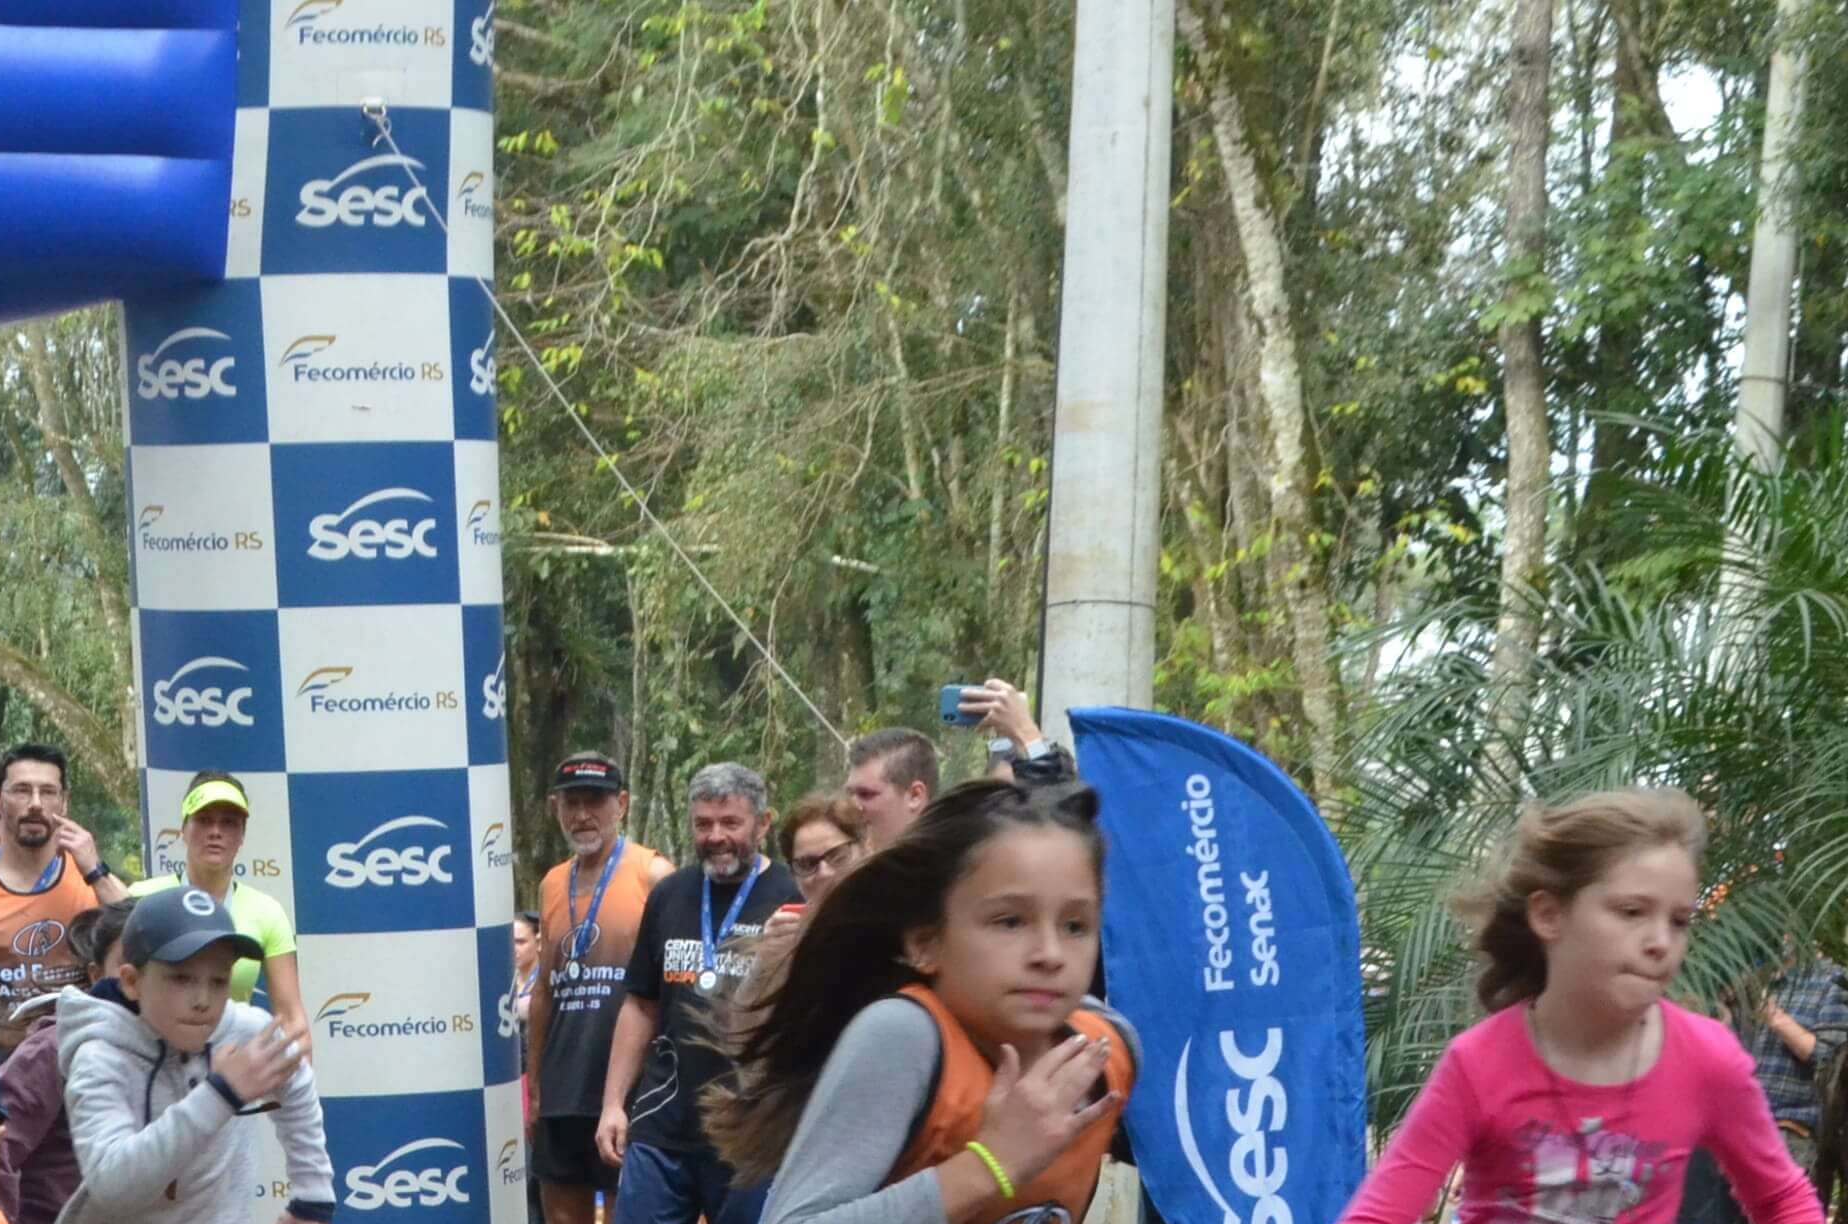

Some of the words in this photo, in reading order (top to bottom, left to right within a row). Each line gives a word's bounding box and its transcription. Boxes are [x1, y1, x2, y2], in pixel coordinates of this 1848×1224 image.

[299, 24, 419, 46] Fecomércio
[424, 27, 446, 46] RS
[295, 179, 426, 228] Sesc
[137, 354, 237, 399] Sesc
[294, 362, 415, 383] Fecomércio
[421, 362, 444, 381] RS
[142, 531, 229, 552] Fecomércio
[234, 531, 263, 551] RS
[307, 514, 438, 561] Sesc
[153, 679, 254, 727] Sesc
[310, 691, 431, 713] Fecomércio
[435, 690, 458, 710] RS
[253, 859, 281, 877] RS
[324, 842, 453, 888] Sesc
[1180, 773, 1235, 993] Fecomércio
[1240, 869, 1280, 988] Senac
[328, 1017, 447, 1038] Fecomércio
[452, 1013, 474, 1033] RS
[344, 1164, 470, 1211] Sesc
